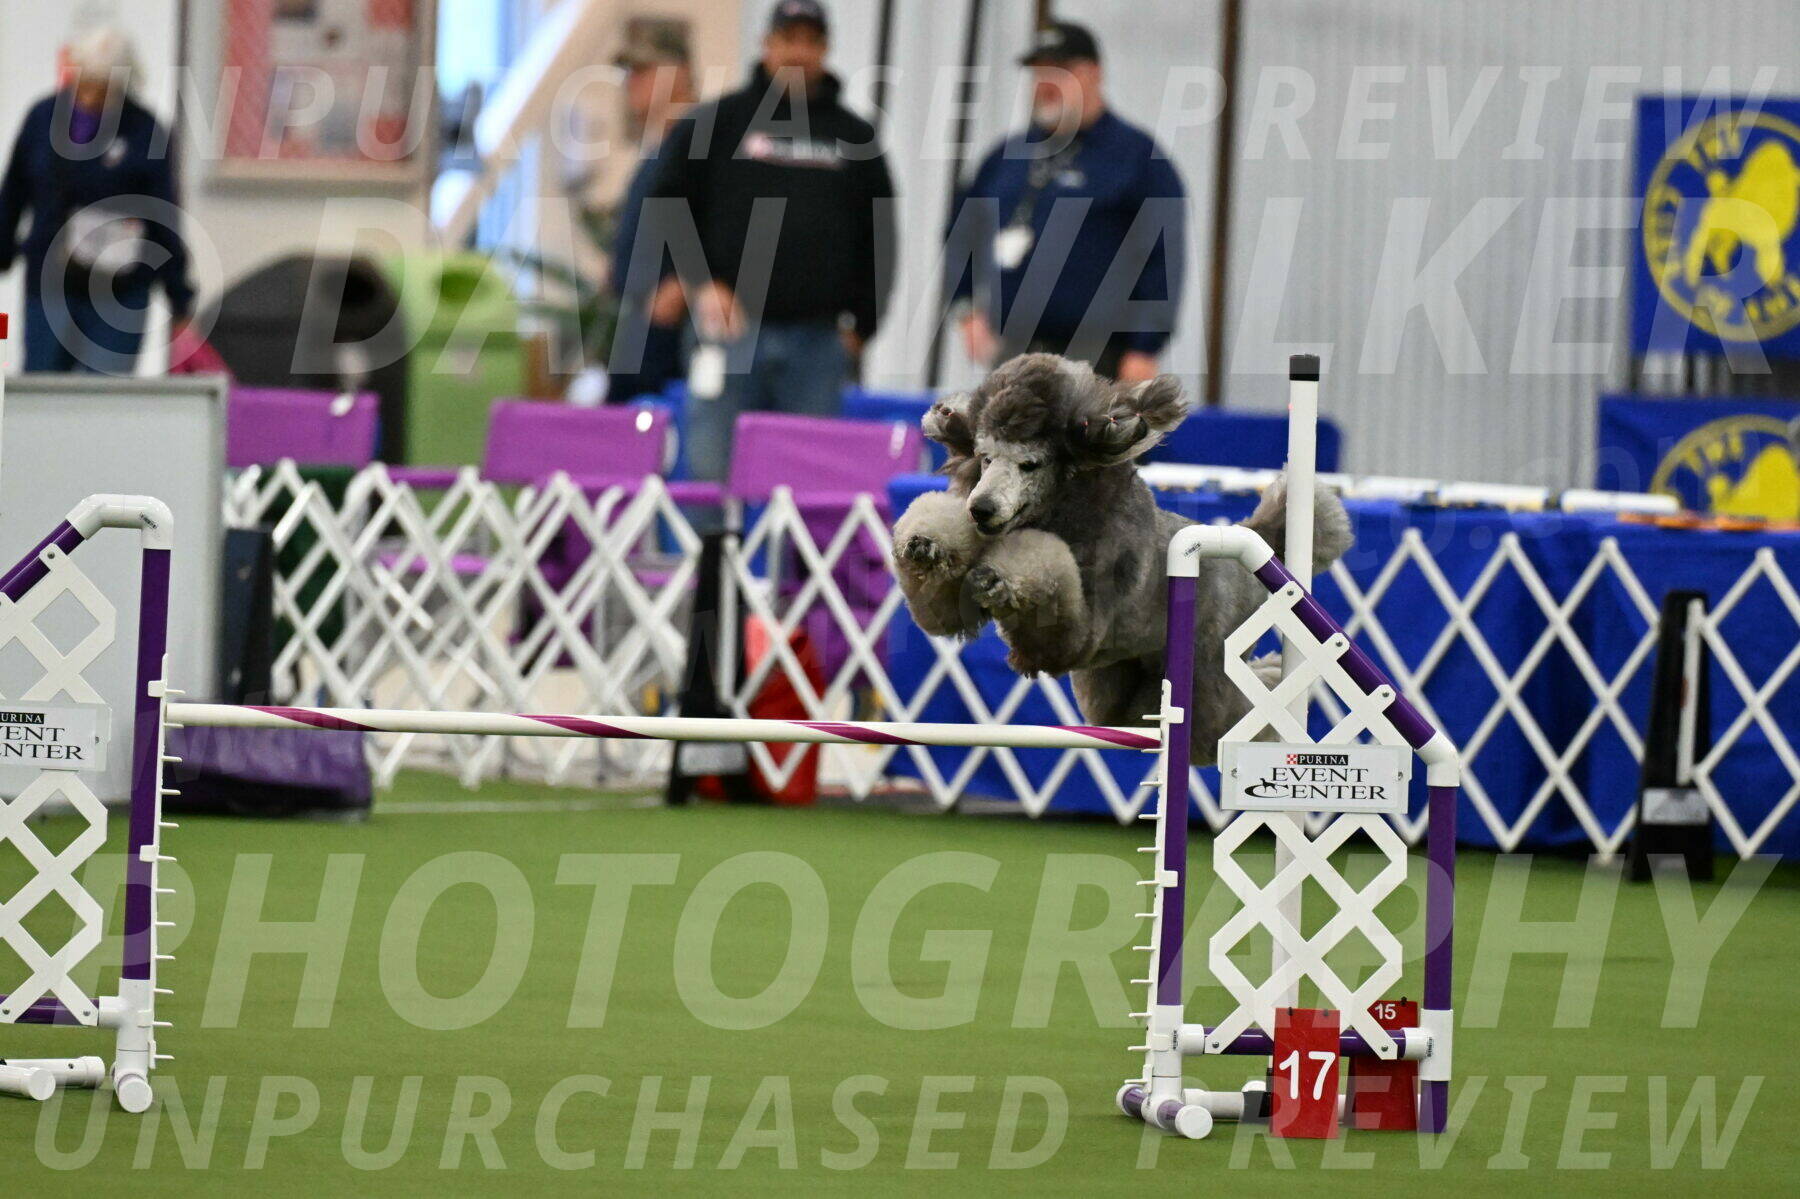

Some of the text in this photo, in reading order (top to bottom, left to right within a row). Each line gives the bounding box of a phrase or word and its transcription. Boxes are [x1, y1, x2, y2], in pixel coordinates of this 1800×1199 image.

[0, 726, 65, 741] ENT
[0, 743, 84, 760] NTER
[1299, 755, 1347, 765] PURINA
[1271, 767, 1369, 783] EVENT
[1244, 783, 1388, 800] CENTER
[1374, 1003, 1397, 1020] 15
[1278, 1049, 1336, 1101] 17
